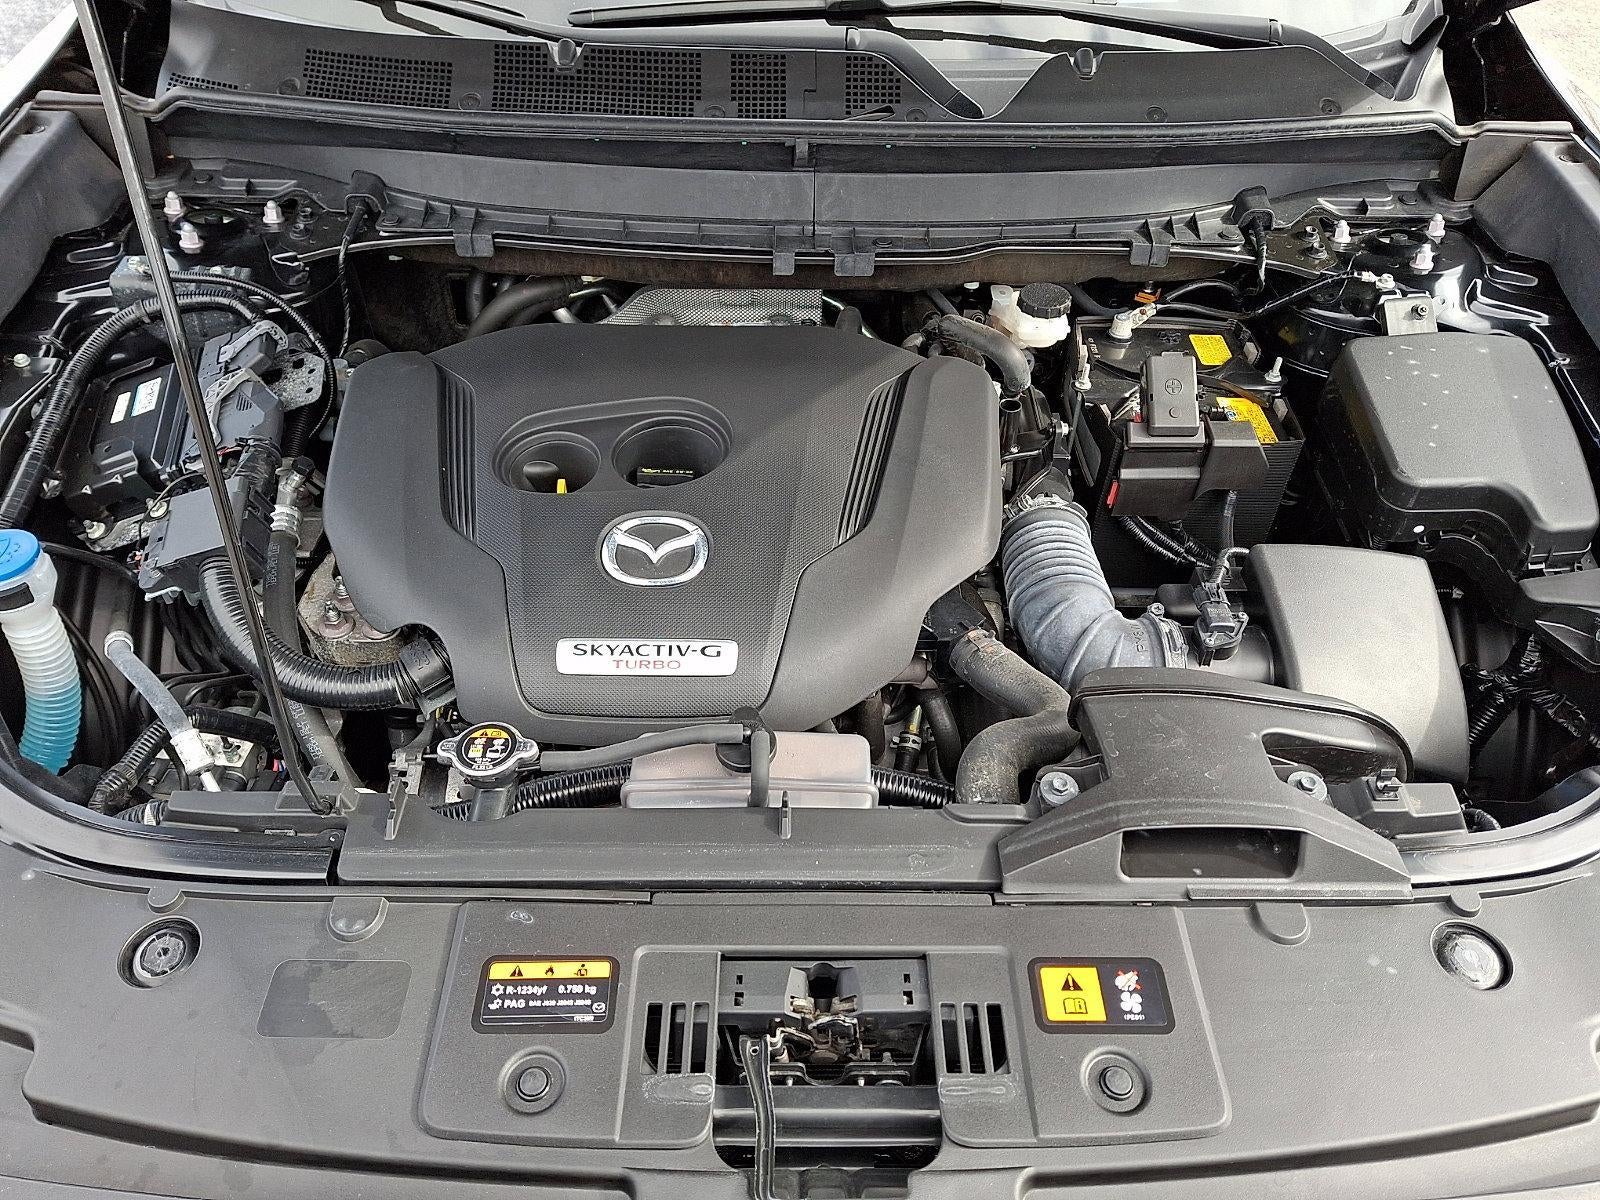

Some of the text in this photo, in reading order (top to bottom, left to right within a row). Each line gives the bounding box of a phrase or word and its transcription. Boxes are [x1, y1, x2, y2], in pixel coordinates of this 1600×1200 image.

[572, 643, 722, 657] SKYACTIV-G
[611, 659, 682, 670] TURBO
[505, 985, 548, 996] R-1234yf
[584, 984, 597, 995] kg
[503, 999, 526, 1009] PAG
